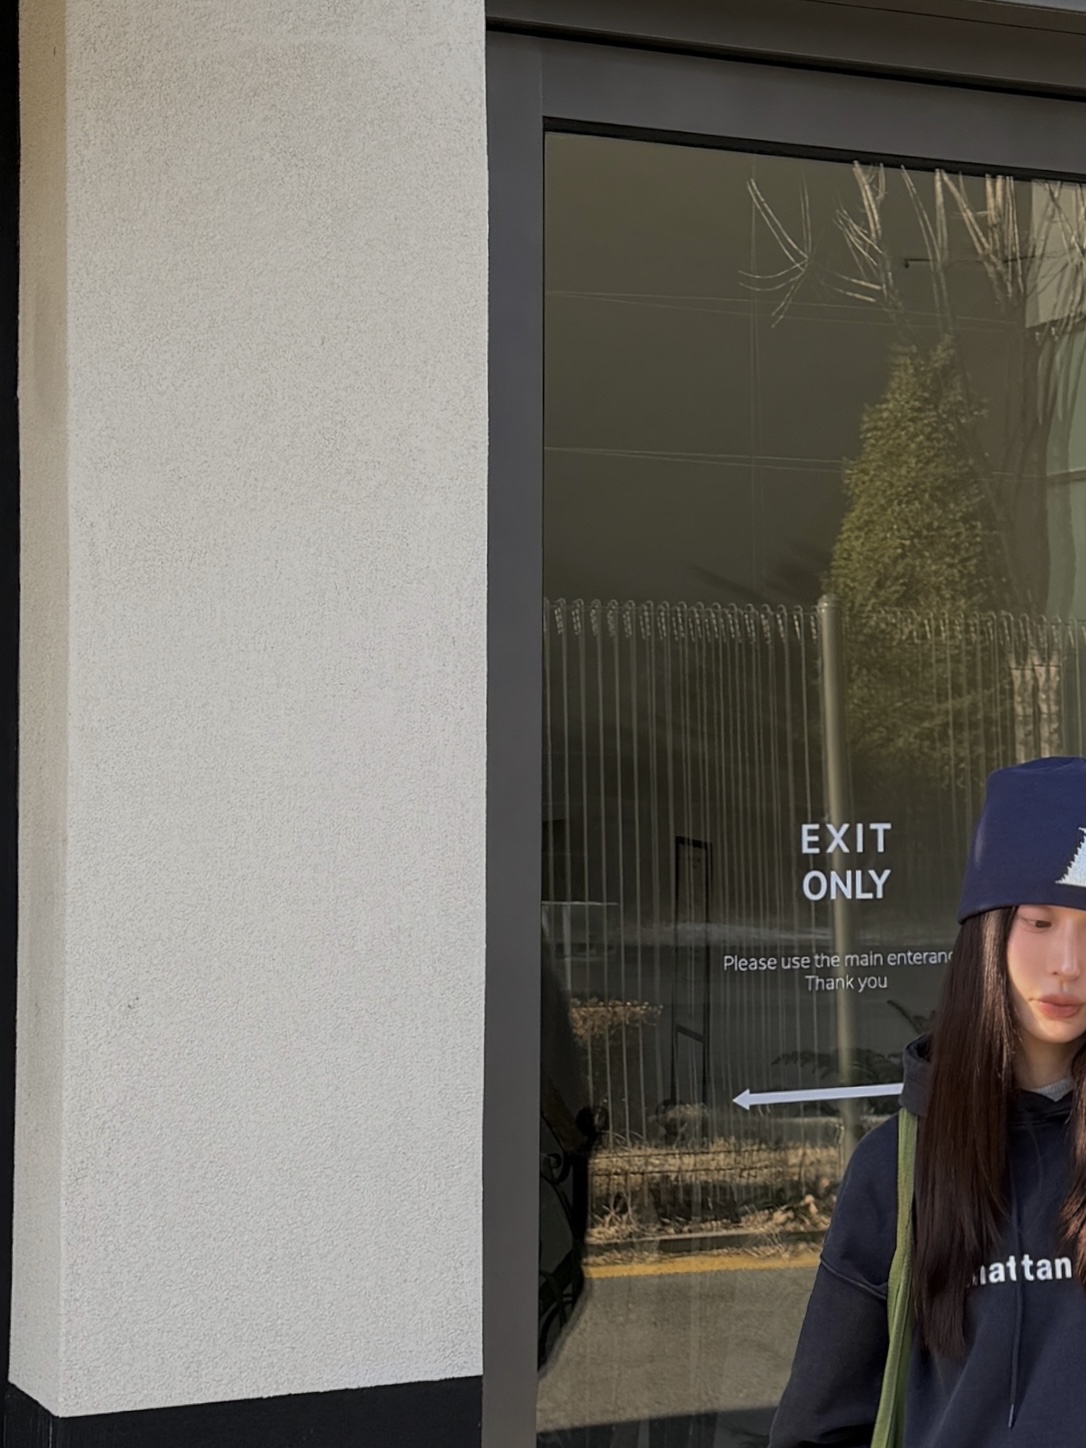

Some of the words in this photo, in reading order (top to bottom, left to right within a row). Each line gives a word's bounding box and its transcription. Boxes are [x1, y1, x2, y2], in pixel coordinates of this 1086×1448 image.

[801, 823, 891, 853] EXIT
[803, 869, 891, 900] ONLY
[724, 955, 777, 971] Please
[781, 955, 811, 969] use
[814, 951, 840, 968] the
[845, 951, 883, 966] main
[805, 975, 854, 991] Thank
[858, 976, 888, 993] you
